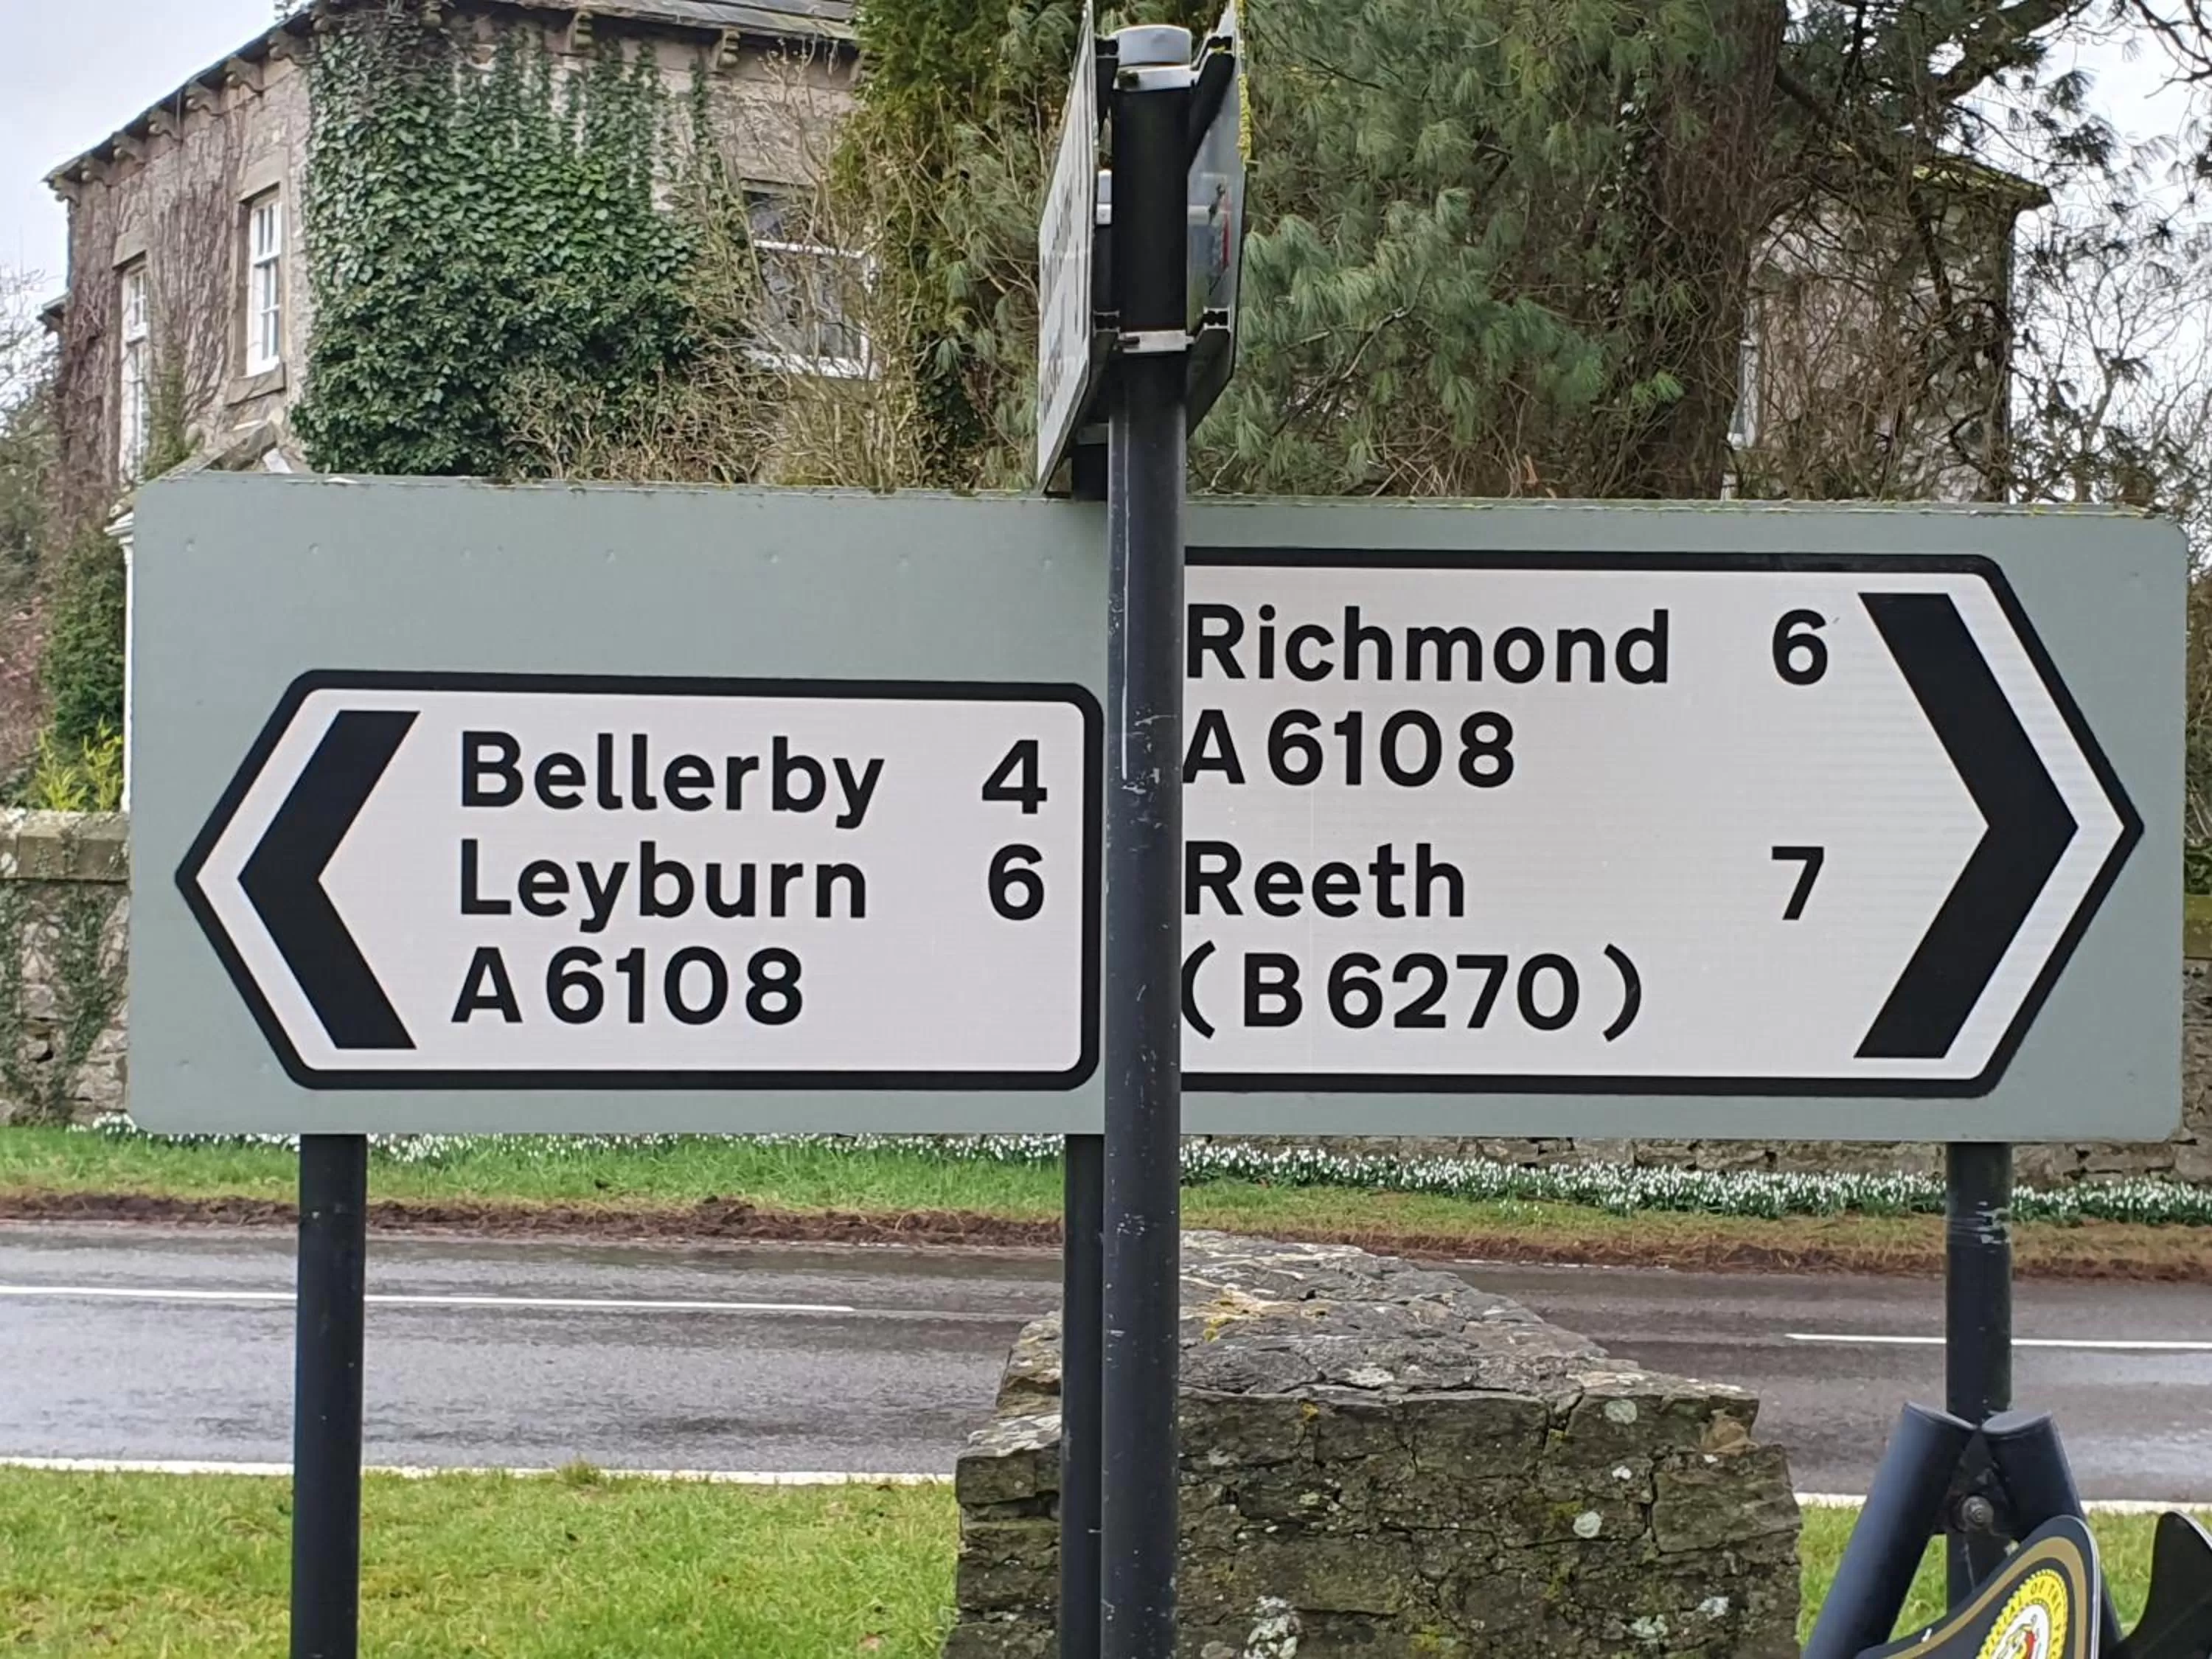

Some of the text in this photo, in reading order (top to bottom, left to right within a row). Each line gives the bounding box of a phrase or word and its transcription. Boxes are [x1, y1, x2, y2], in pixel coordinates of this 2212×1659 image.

[1186, 603, 1828, 686] Richmond 6
[462, 731, 1048, 830] Bellerby 4
[461, 838, 1045, 933] Leyburn 6
[1184, 840, 1824, 921] Reeth 7
